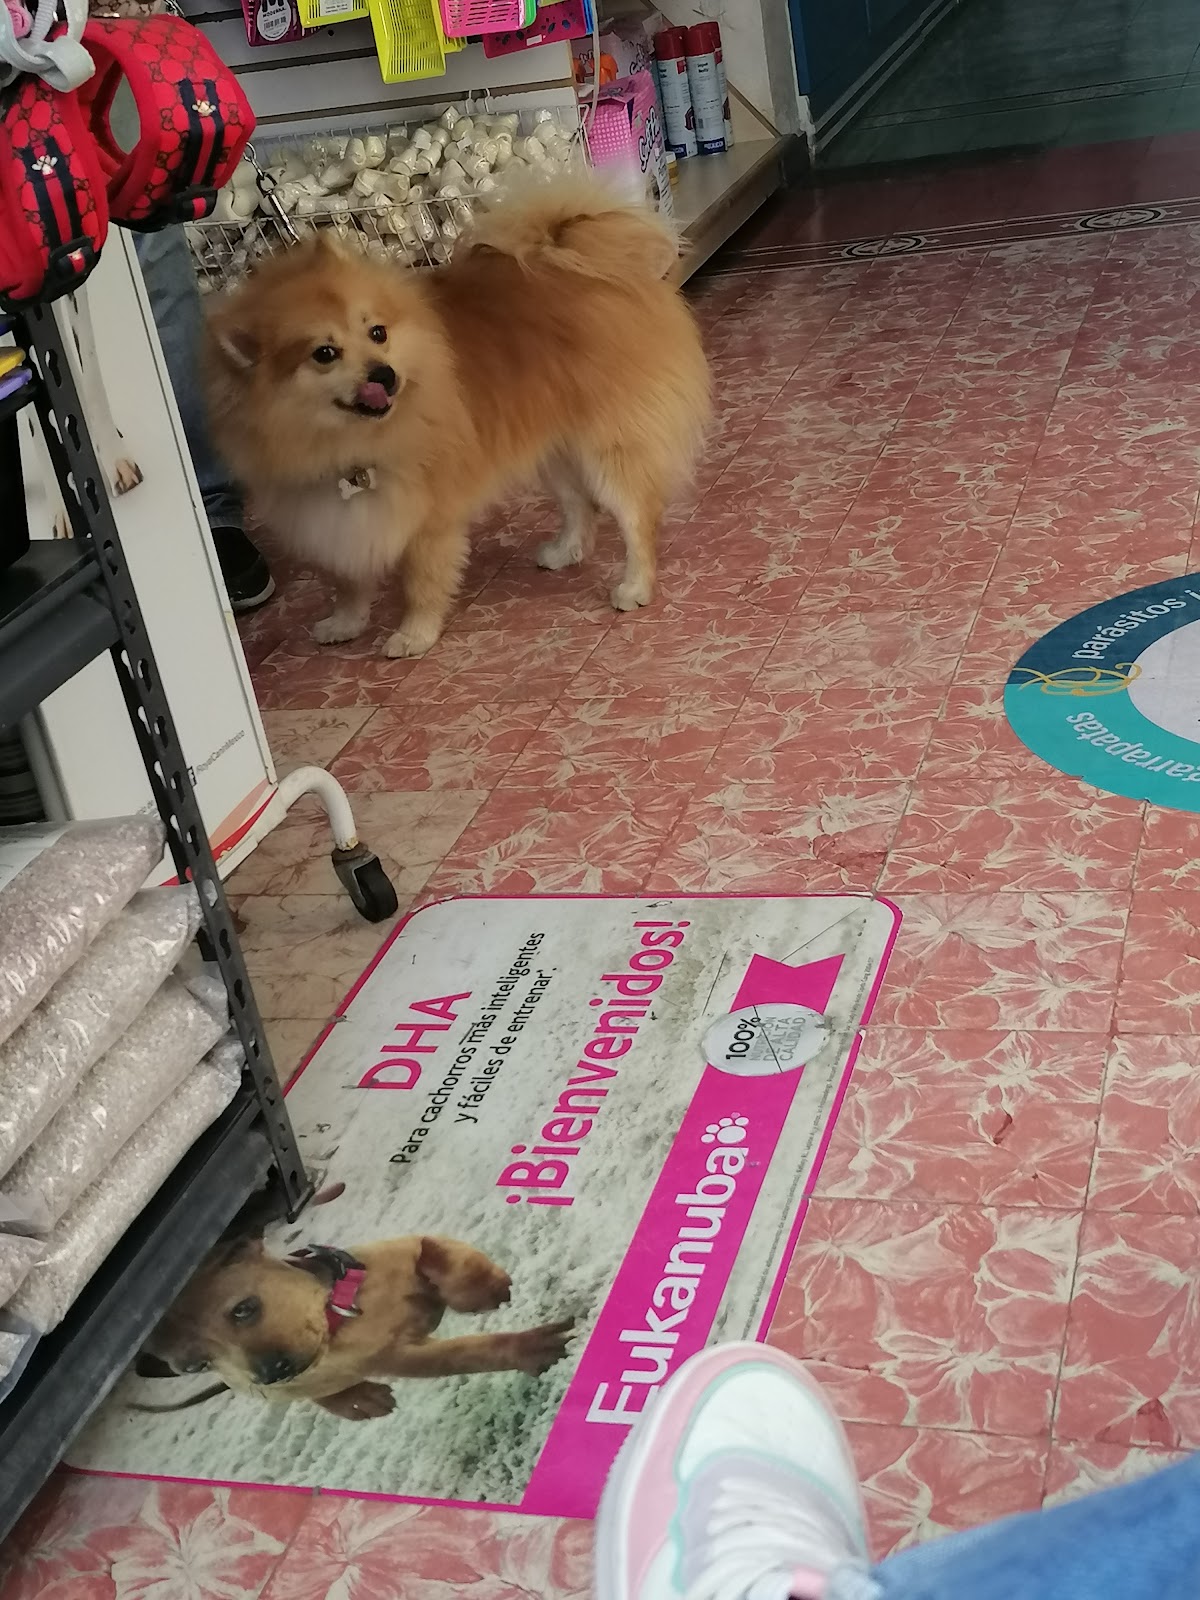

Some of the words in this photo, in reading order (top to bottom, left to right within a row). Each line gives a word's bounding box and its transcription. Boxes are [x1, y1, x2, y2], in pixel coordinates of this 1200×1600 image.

[1071, 597, 1187, 660] parásitos
[480, 931, 545, 1011] inteligentes
[357, 990, 473, 1090] DHA
[466, 1013, 497, 1044] más
[489, 1035, 518, 1056] de
[725, 1016, 762, 1060] 100%
[769, 1016, 792, 1043] ALTA
[779, 1016, 806, 1061] CALIDAD
[495, 920, 691, 1206] ¡Bienvenidos!
[762, 1047, 781, 1062] DE
[421, 1045, 477, 1123] cachorros
[457, 1057, 504, 1108] fáciles
[453, 1111, 479, 1125] y
[388, 1126, 430, 1164] Para
[584, 1146, 750, 1426] Eukanuba
